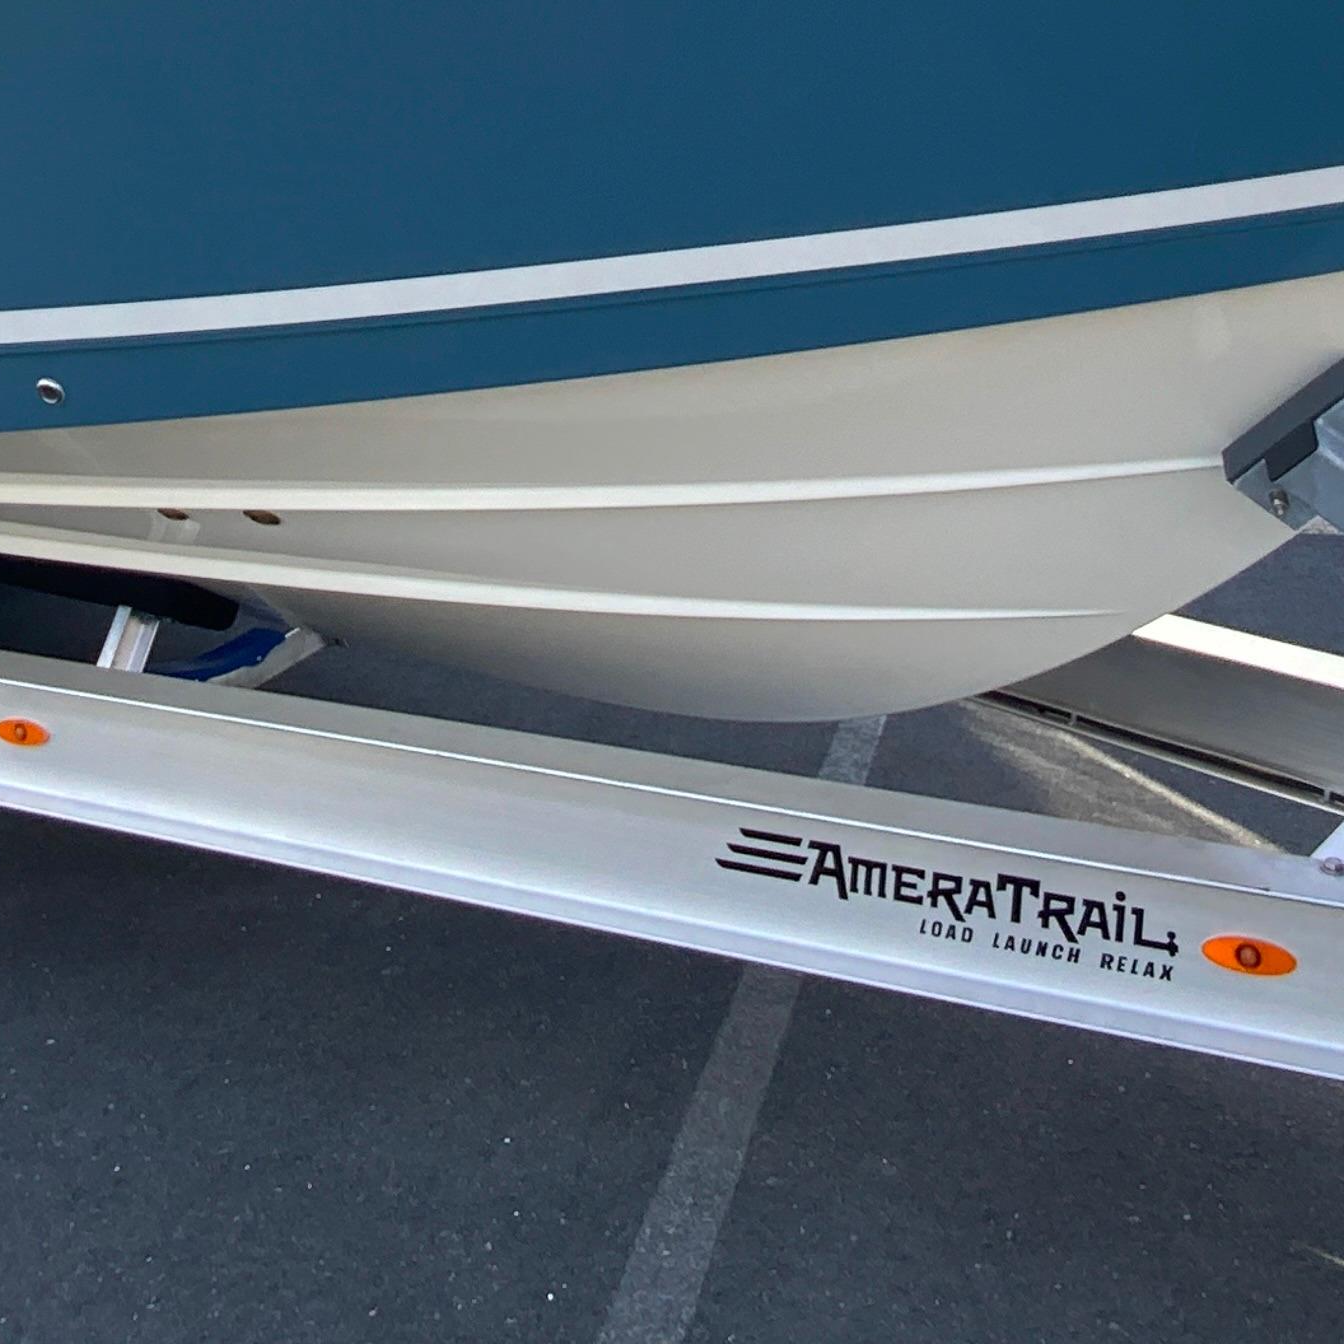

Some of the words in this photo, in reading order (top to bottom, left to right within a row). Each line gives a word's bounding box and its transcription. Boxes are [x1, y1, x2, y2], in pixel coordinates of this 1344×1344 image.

[919, 918, 975, 944] LOAD
[992, 934, 1082, 965] LAUNCH
[1099, 953, 1175, 982] RELAX
